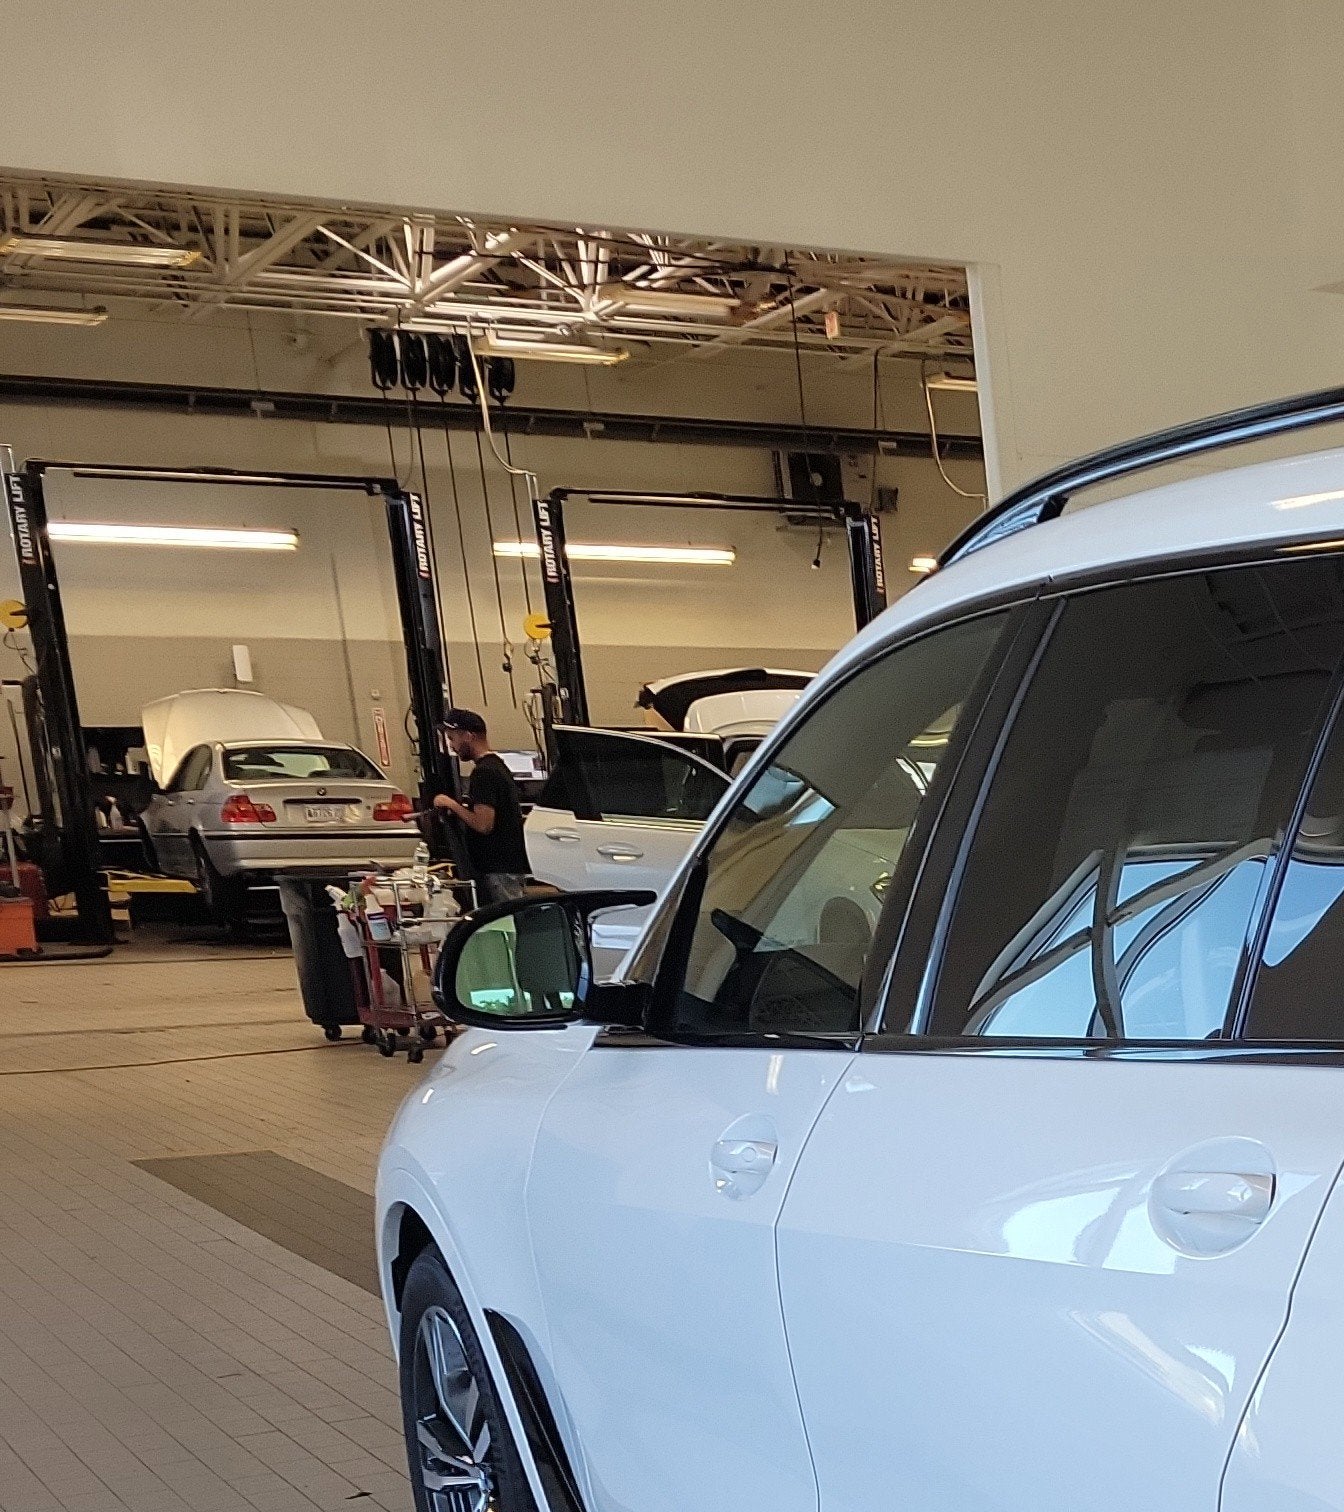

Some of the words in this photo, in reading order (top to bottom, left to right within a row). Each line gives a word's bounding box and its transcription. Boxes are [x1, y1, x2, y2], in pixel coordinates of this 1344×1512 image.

[9, 474, 25, 503] LIFT
[410, 492, 422, 521] LIFT
[14, 505, 34, 558] ROTARY
[537, 500, 552, 527] LIFT
[412, 521, 429, 573] ROTARY
[541, 528, 559, 577] ROTARY
